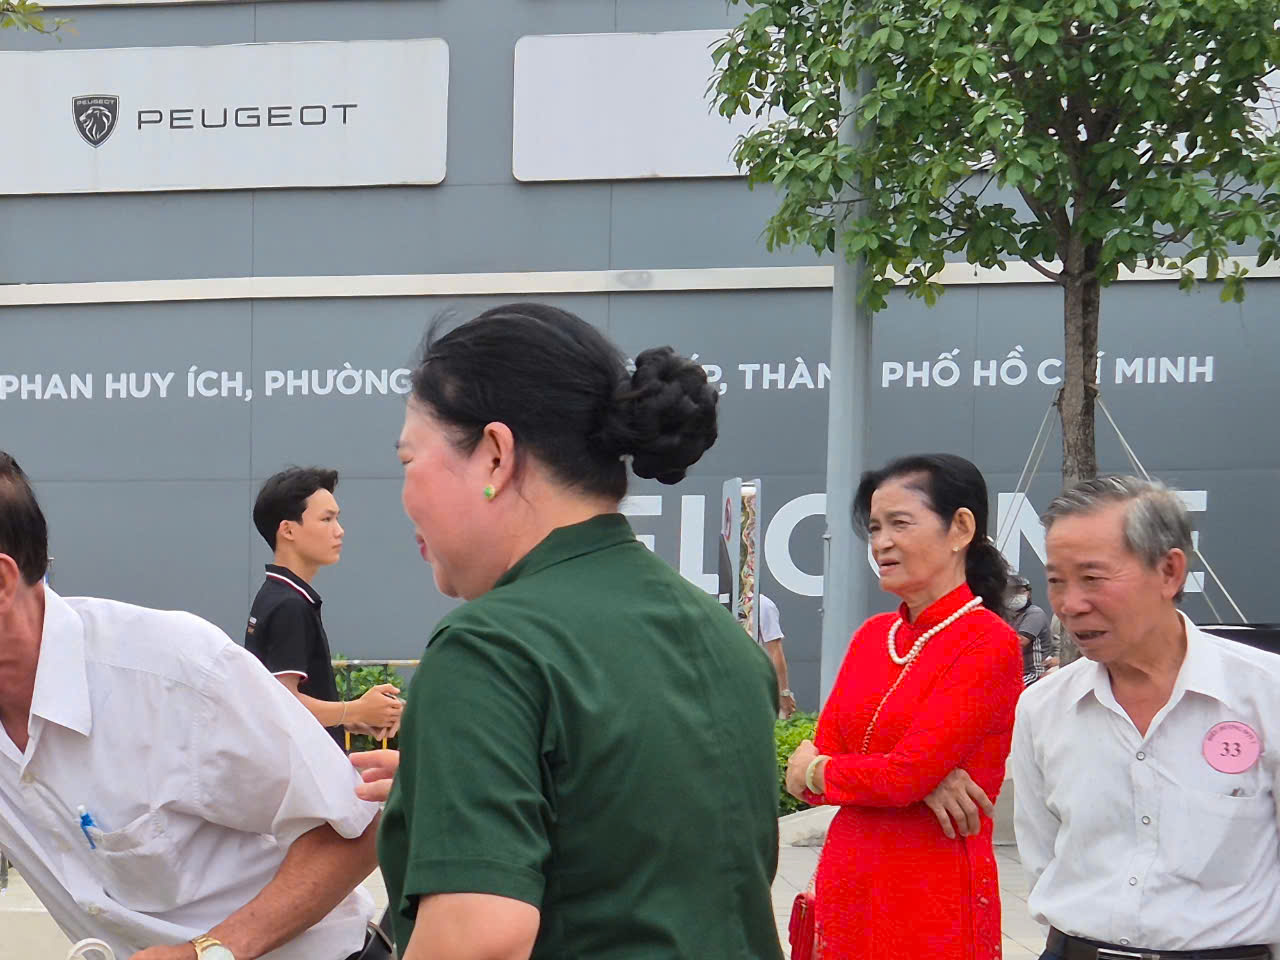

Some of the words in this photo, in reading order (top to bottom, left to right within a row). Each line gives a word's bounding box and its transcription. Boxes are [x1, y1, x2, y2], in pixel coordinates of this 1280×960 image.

[137, 103, 358, 130] PEUGEOT
[0, 373, 93, 400] PHAN
[105, 371, 175, 398] HUY
[187, 365, 254, 402] ÍCH,
[265, 362, 413, 396] PHƯỜNG
[738, 356, 832, 389] THÀN
[881, 347, 961, 388] PHỐ
[973, 344, 1028, 386] HỒ
[1037, 350, 1105, 385] CÍ
[1114, 356, 1215, 385] MINH
[1219, 741, 1241, 758] 33
